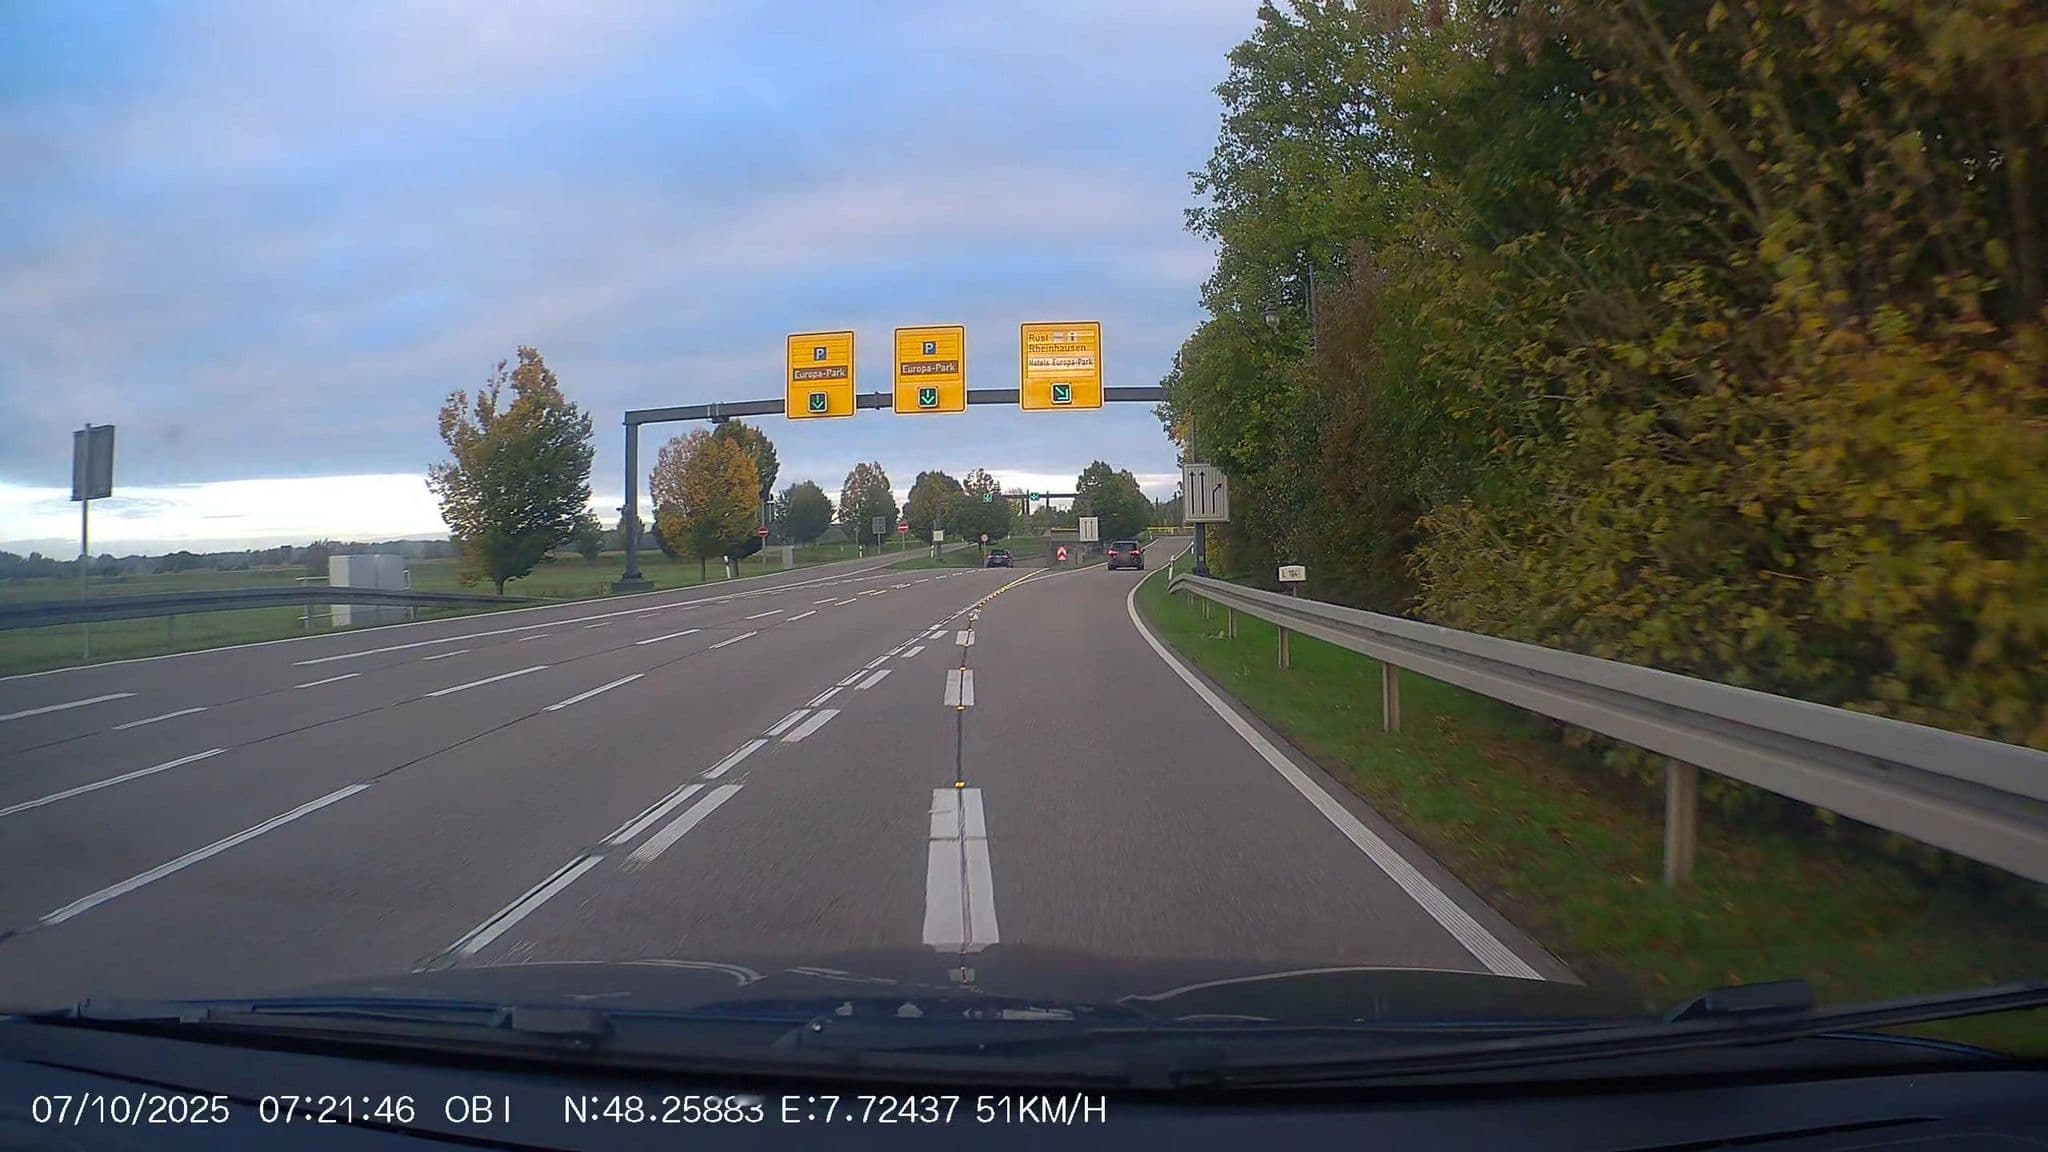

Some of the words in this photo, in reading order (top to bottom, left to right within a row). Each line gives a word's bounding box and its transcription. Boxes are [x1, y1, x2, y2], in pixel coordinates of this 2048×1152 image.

[1028, 333, 1049, 342] Rust
[816, 348, 825, 360] P
[925, 342, 934, 354] P
[1028, 343, 1087, 353] Rheinhausen
[902, 362, 956, 374] Europa-Park
[1052, 358, 1095, 369] Europa-Park
[794, 368, 846, 380] Europa-Park
